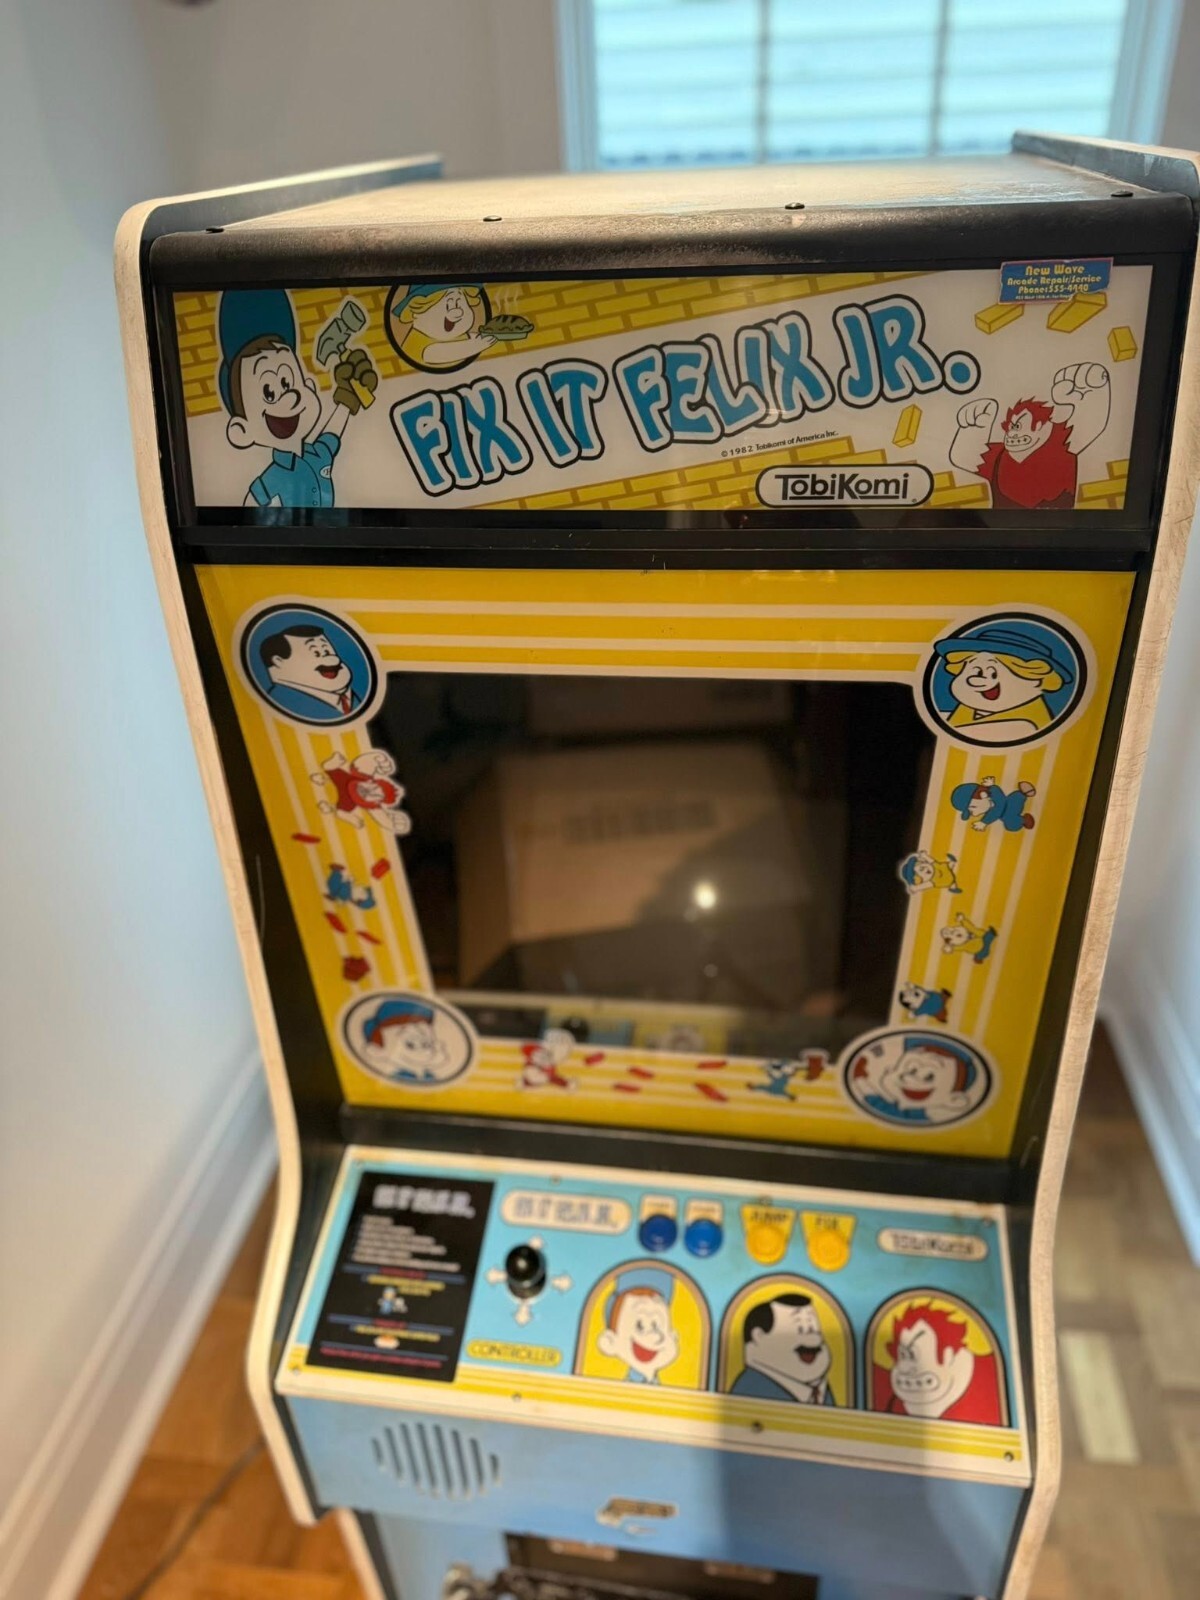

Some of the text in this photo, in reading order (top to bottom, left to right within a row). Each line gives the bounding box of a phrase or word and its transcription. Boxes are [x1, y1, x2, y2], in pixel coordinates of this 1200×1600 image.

[1007, 277, 1038, 286] Arcade
[1025, 264, 1085, 276] New Wave
[390, 294, 982, 497] FIX IT FELIX JR.
[730, 445, 753, 456] 1982
[755, 440, 786, 451] Tobikomi
[787, 437, 795, 445] of
[795, 433, 826, 443] America
[825, 430, 839, 438] Inc.
[774, 473, 910, 501] TobiKomi
